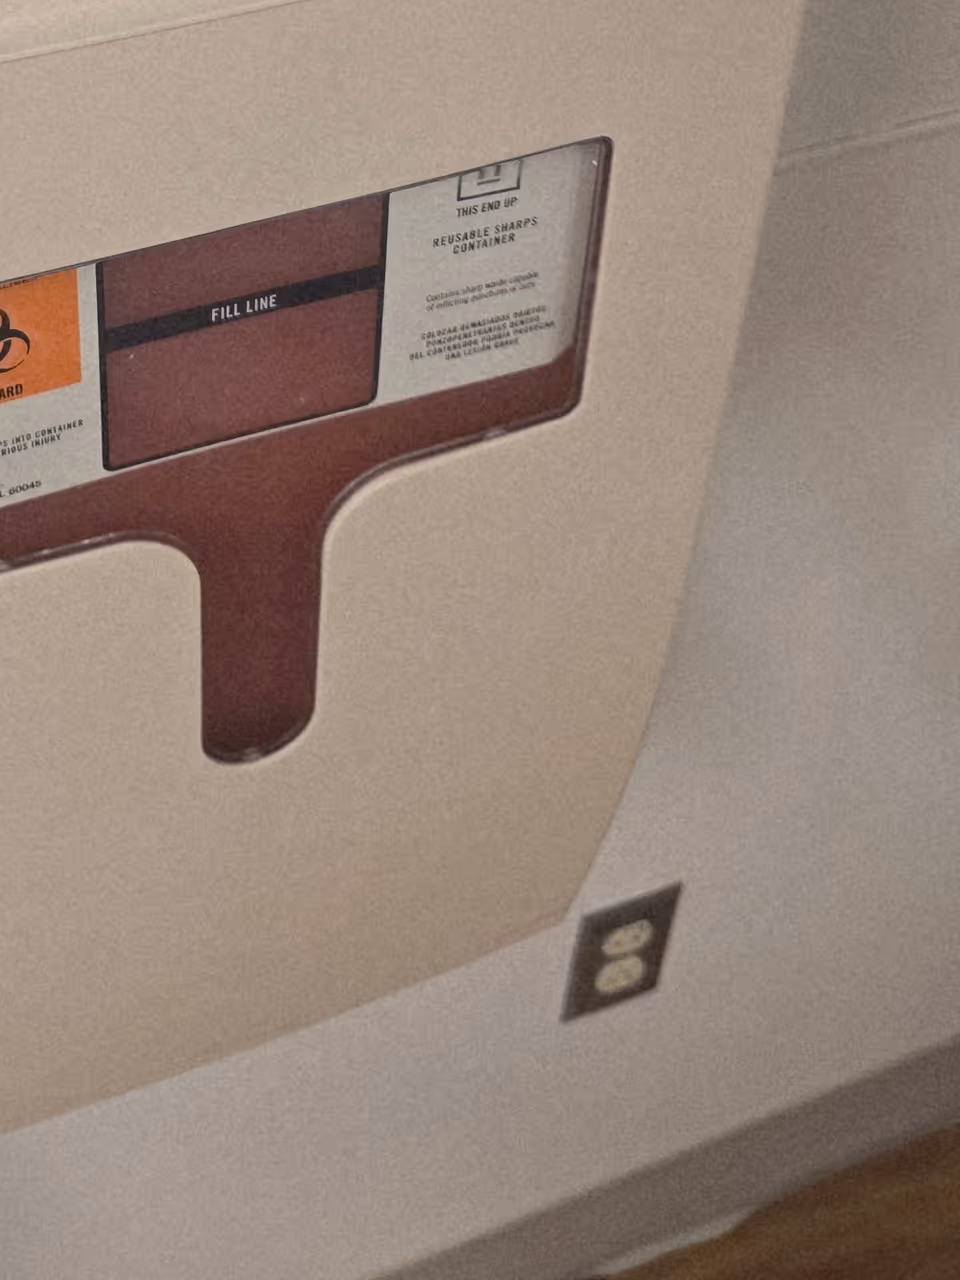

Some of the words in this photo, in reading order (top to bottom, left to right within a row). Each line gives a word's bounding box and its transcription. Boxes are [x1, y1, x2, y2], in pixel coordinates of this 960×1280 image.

[456, 205, 479, 218] THIS
[481, 200, 501, 213] END
[504, 196, 518, 208] UP
[432, 226, 490, 248] REUSABLE
[494, 216, 538, 235] SHARPS
[453, 233, 516, 255] CONTAINER
[211, 303, 240, 322] FILL
[246, 294, 277, 313] LINE
[11, 433, 32, 445] INTO
[34, 419, 84, 438] CONTAINER
[32, 433, 62, 448] INJURY
